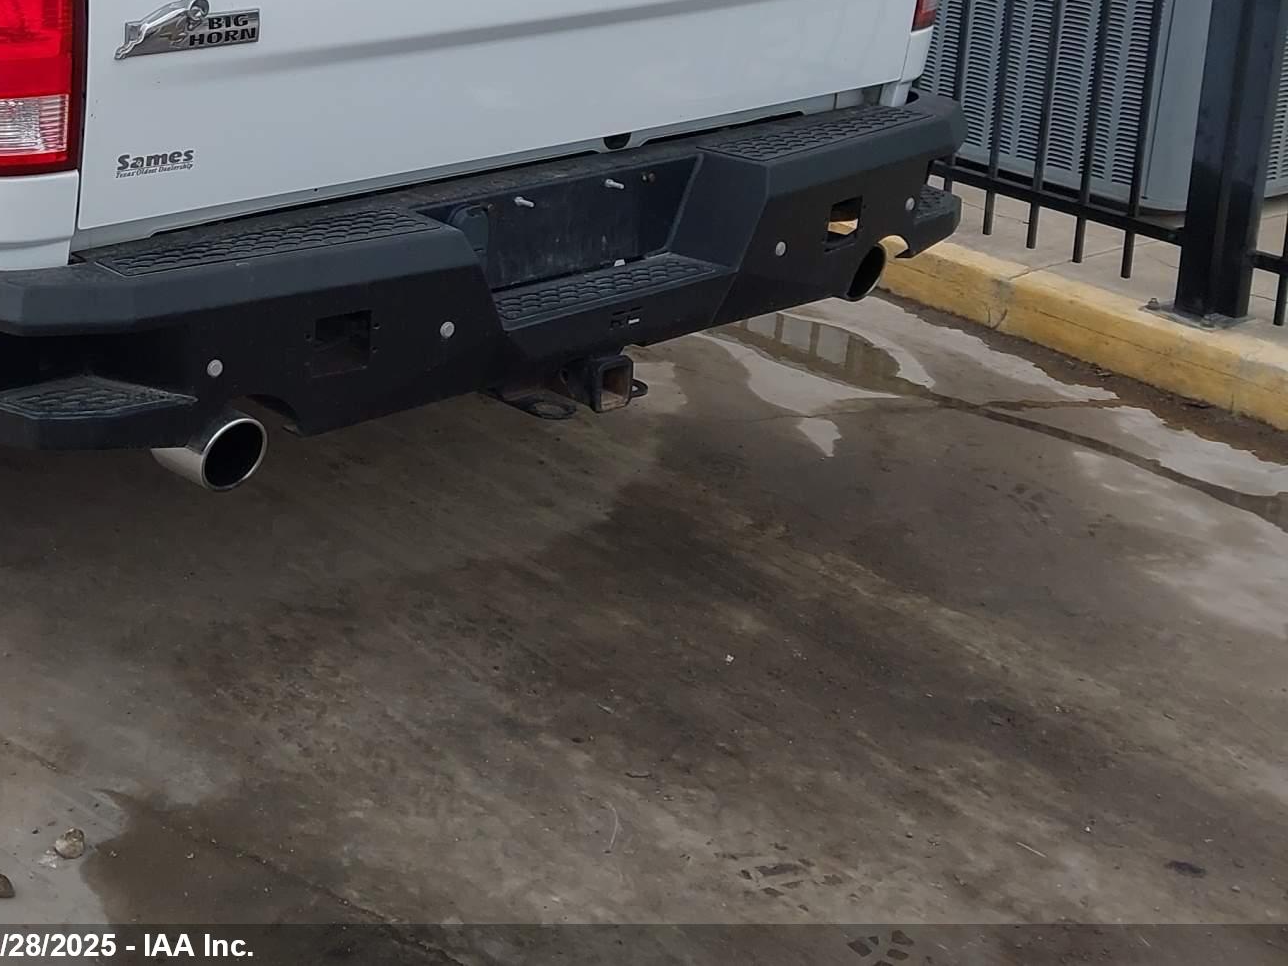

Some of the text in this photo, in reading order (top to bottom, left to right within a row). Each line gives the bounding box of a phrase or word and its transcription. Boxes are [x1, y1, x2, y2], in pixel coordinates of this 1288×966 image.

[208, 14, 249, 30] BIG
[189, 28, 256, 46] HORN
[116, 149, 194, 171] Sames
